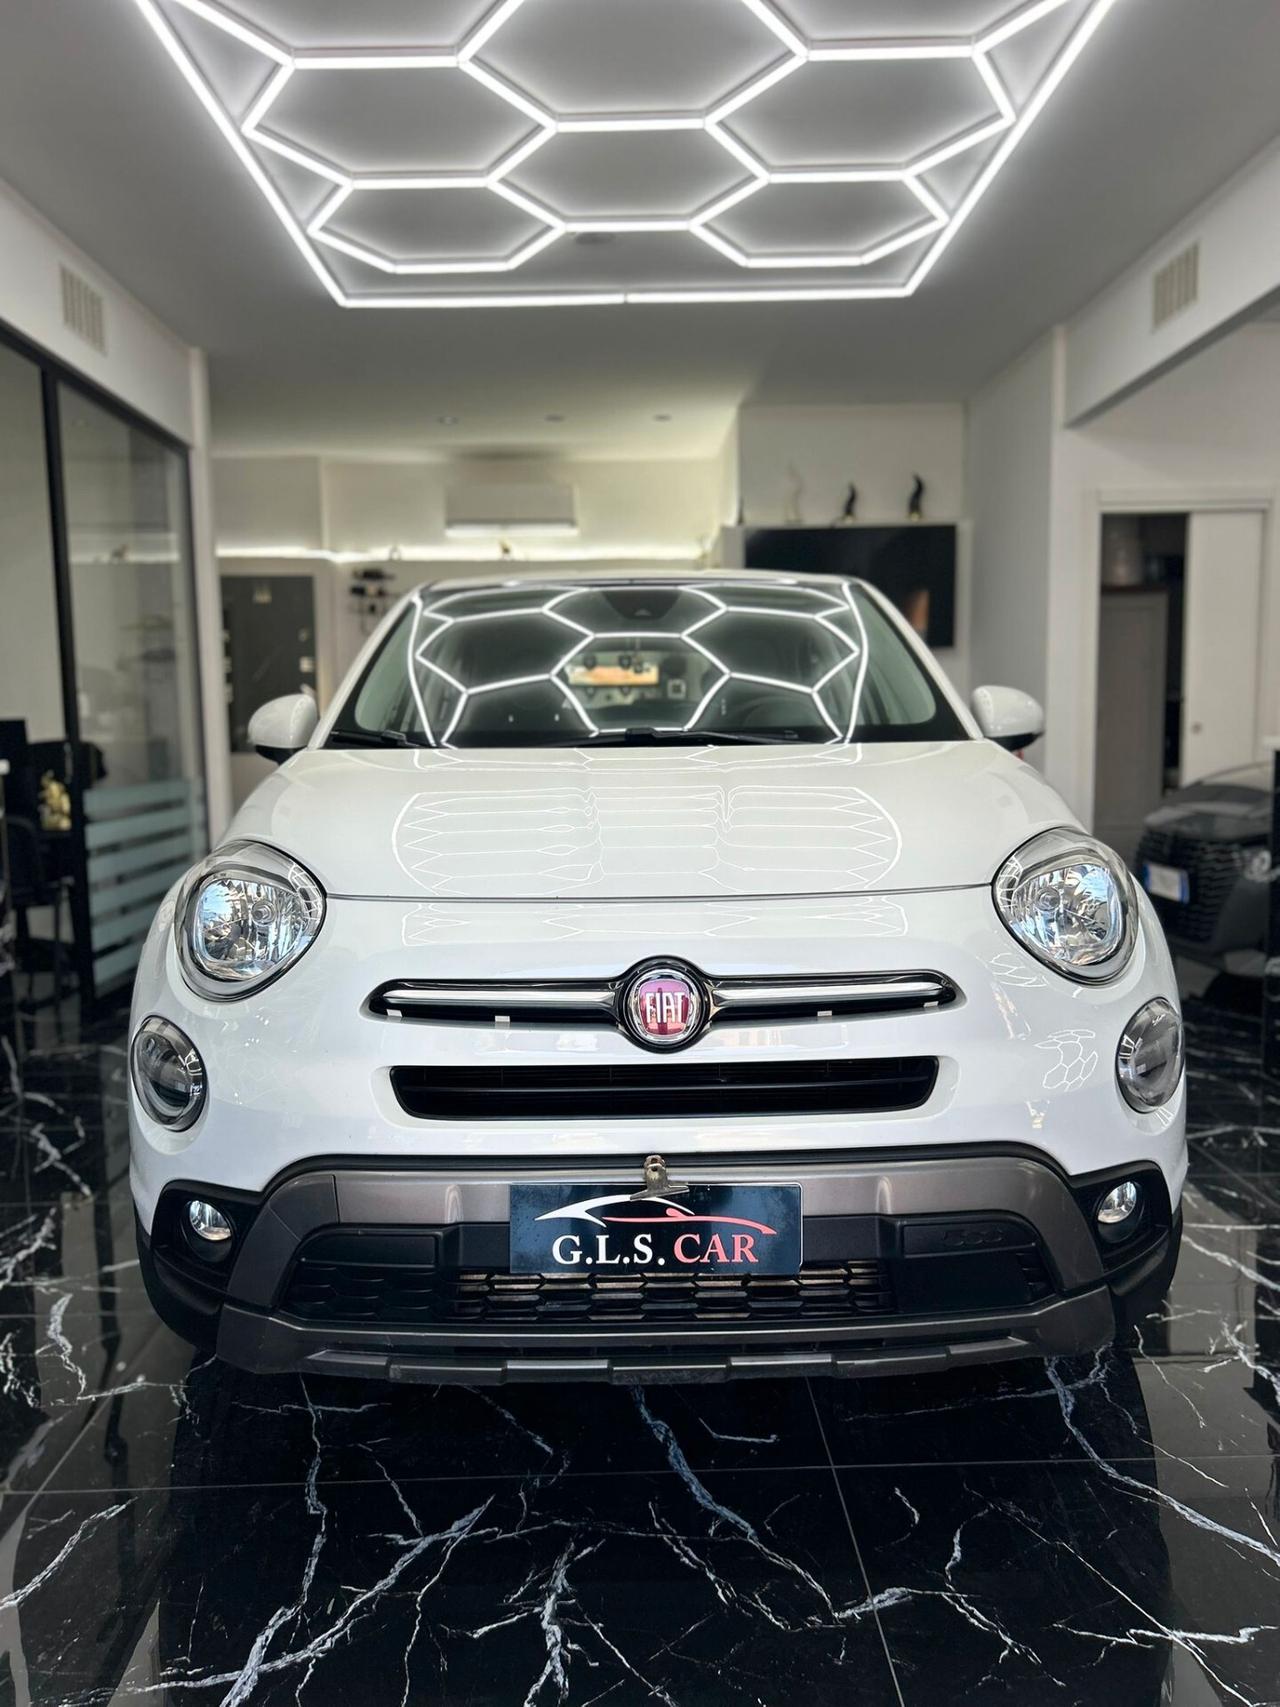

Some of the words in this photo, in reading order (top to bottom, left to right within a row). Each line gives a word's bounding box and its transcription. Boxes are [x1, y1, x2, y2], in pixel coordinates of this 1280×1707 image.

[645, 992, 685, 1023] FIAT
[552, 1234, 665, 1265] G.L.S.
[674, 1234, 758, 1263] CAR
